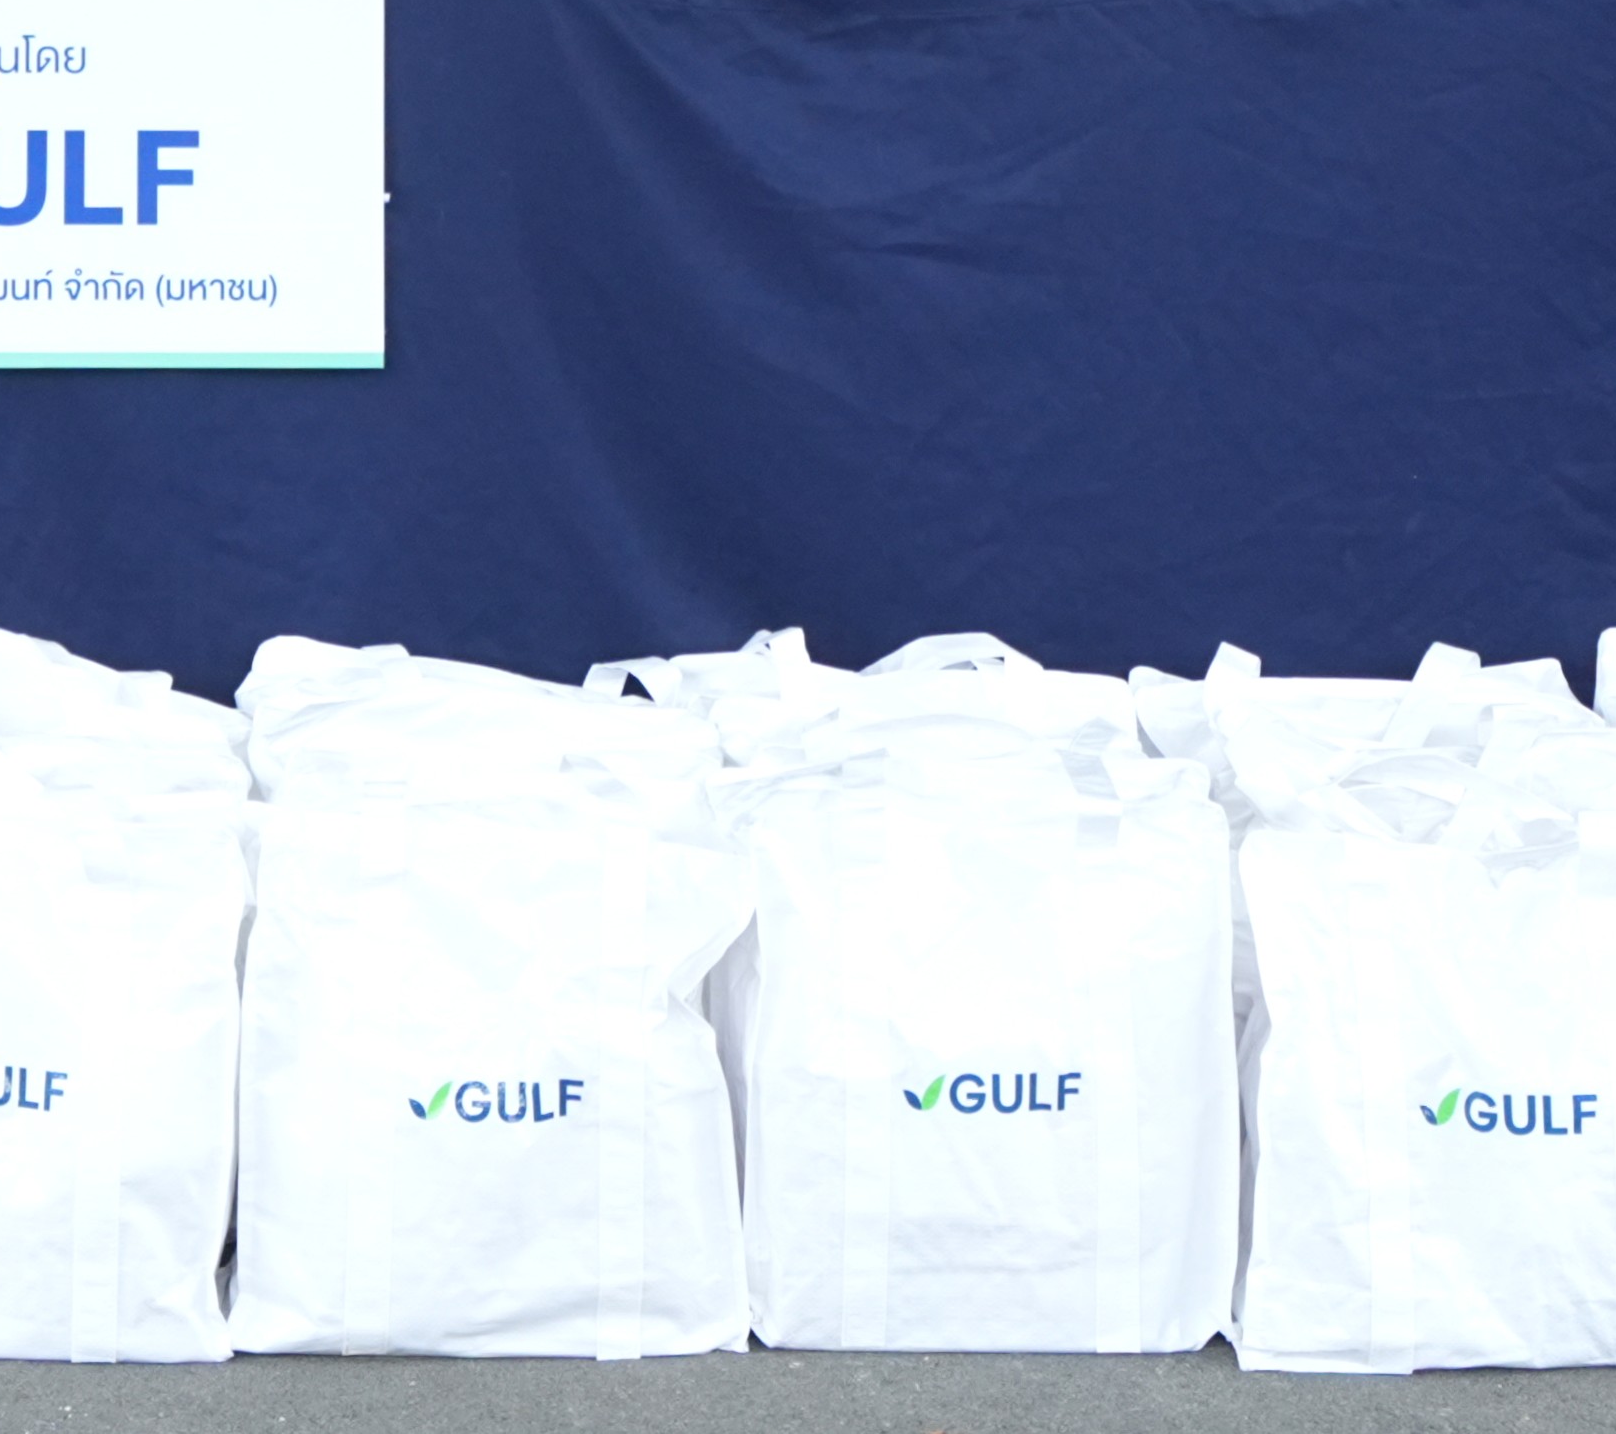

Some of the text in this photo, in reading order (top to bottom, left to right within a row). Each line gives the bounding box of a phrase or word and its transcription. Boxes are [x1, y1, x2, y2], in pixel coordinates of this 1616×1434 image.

[64, 268, 146, 301] จำกัด
[154, 274, 280, 307] (มหาชน)
[455, 1078, 585, 1124] GULF
[950, 1071, 1082, 1114] GULF
[1464, 1090, 1599, 1136] GULF
